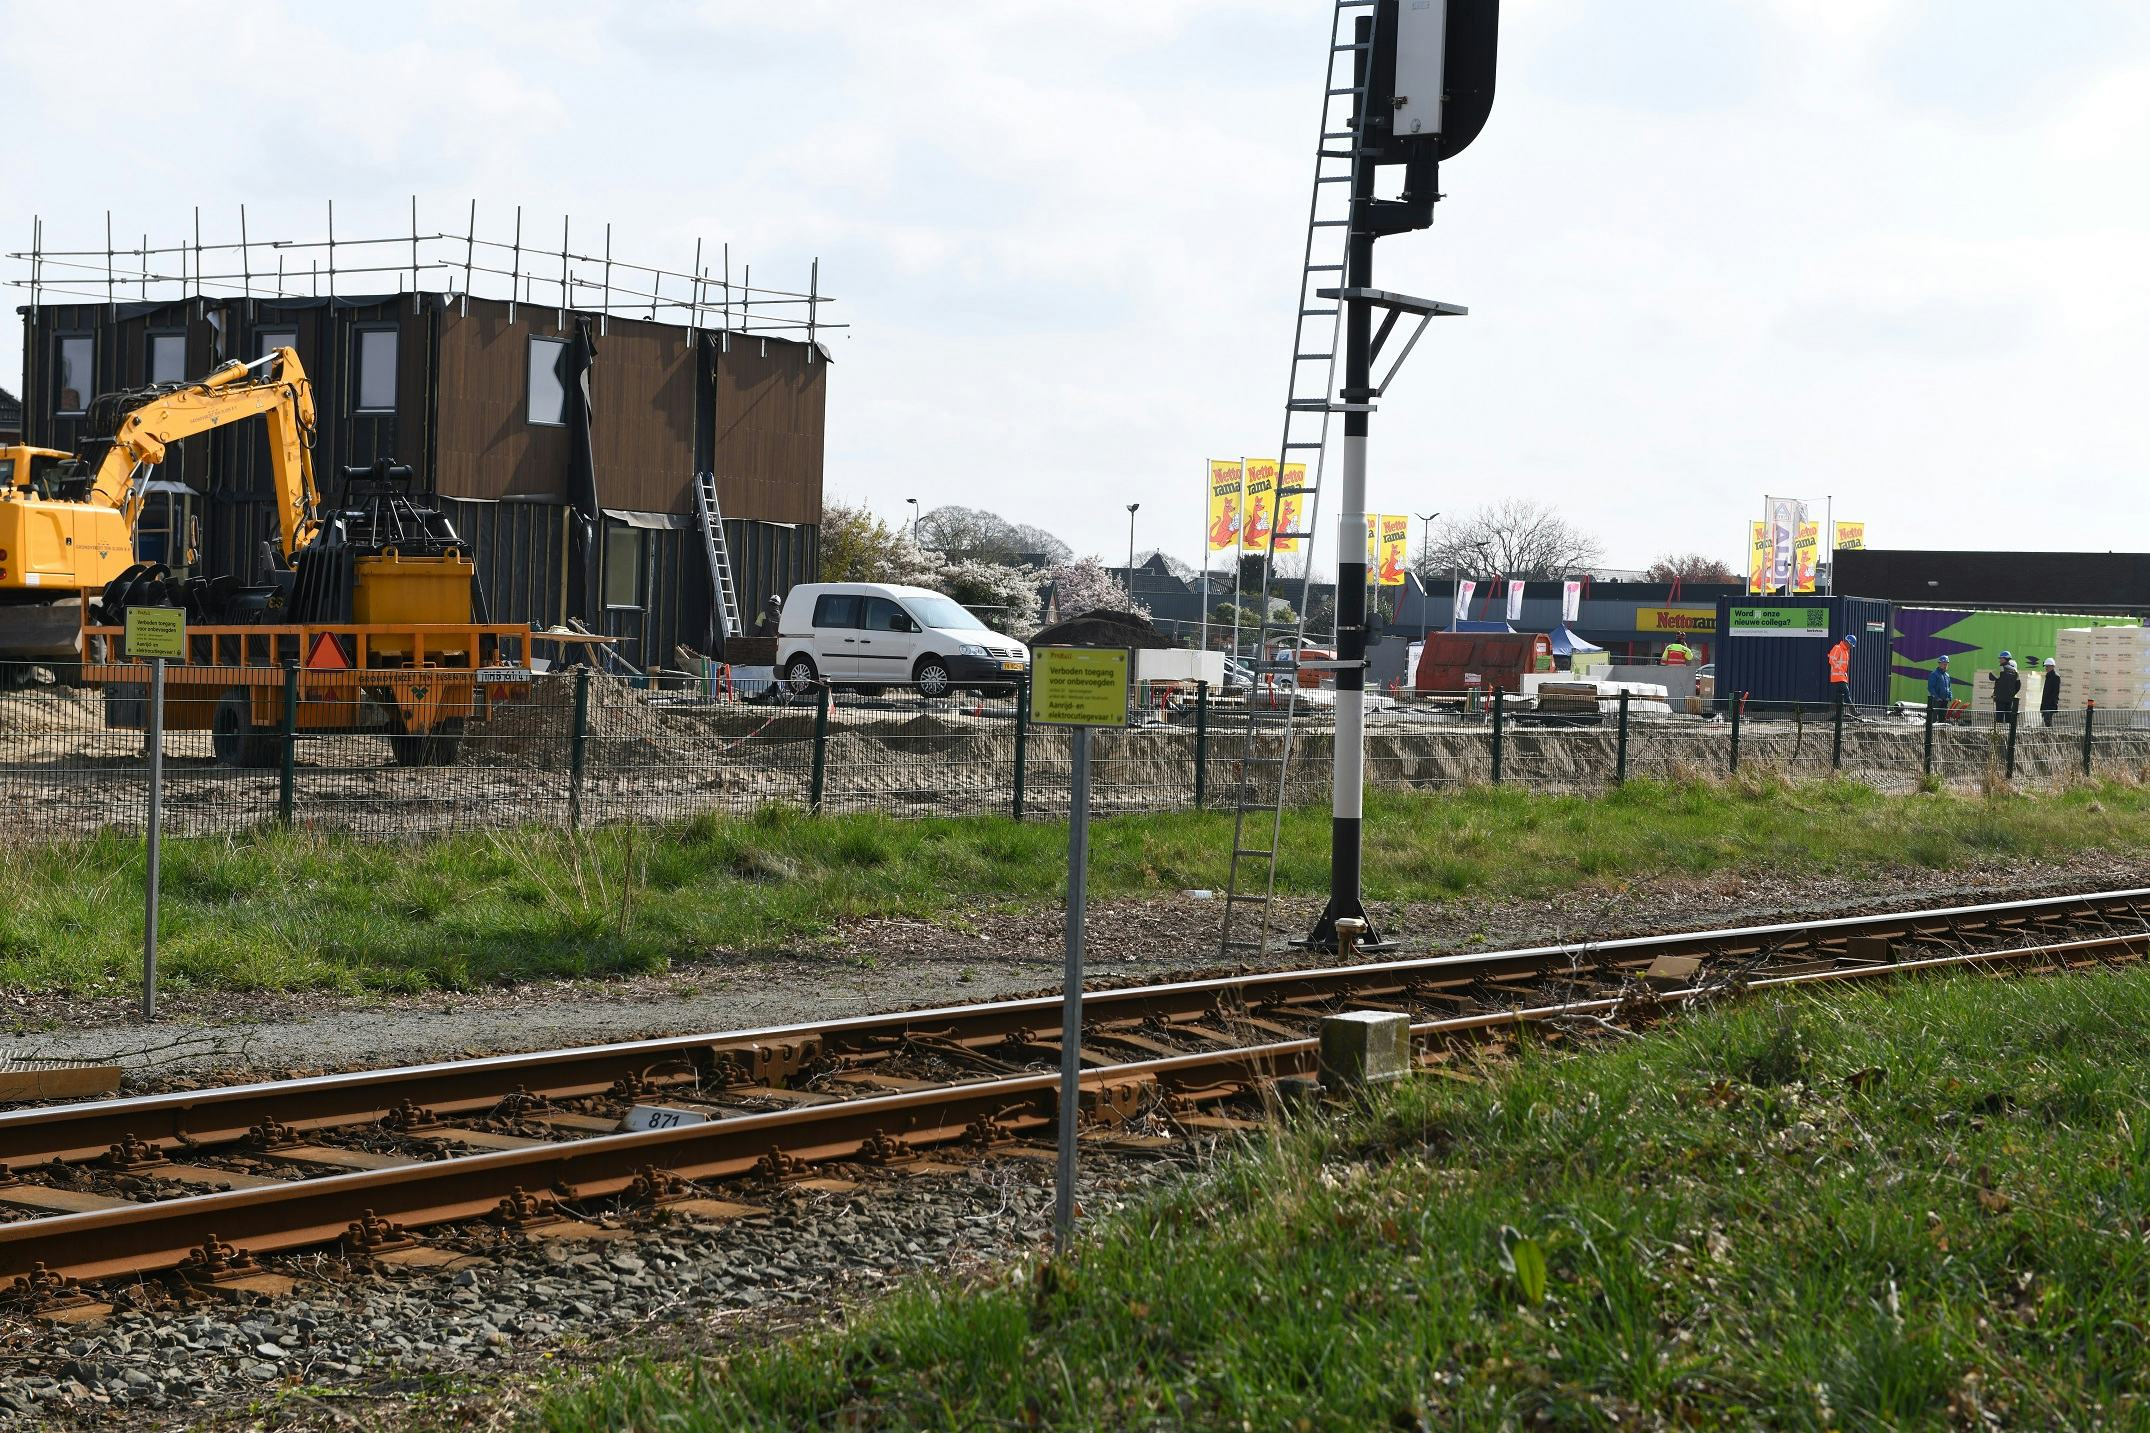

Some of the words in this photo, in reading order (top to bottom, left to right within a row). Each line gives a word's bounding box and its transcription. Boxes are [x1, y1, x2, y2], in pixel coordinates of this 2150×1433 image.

[1248, 465, 1274, 482] Netto
[1213, 481, 1240, 496] rama
[1247, 479, 1272, 495] rama
[1383, 521, 1406, 533] Netto
[1383, 531, 1406, 543] rama
[1838, 527, 1862, 540] Netto
[1775, 524, 1789, 584] ALDI
[1761, 618, 1791, 628] collega?
[1050, 667, 1083, 675] Verboden
[1085, 668, 1114, 678] toegang
[1067, 678, 1115, 687] onbevoegden
[1048, 711, 1108, 721] elektrocutiegevaar
[648, 1112, 680, 1129] 871
